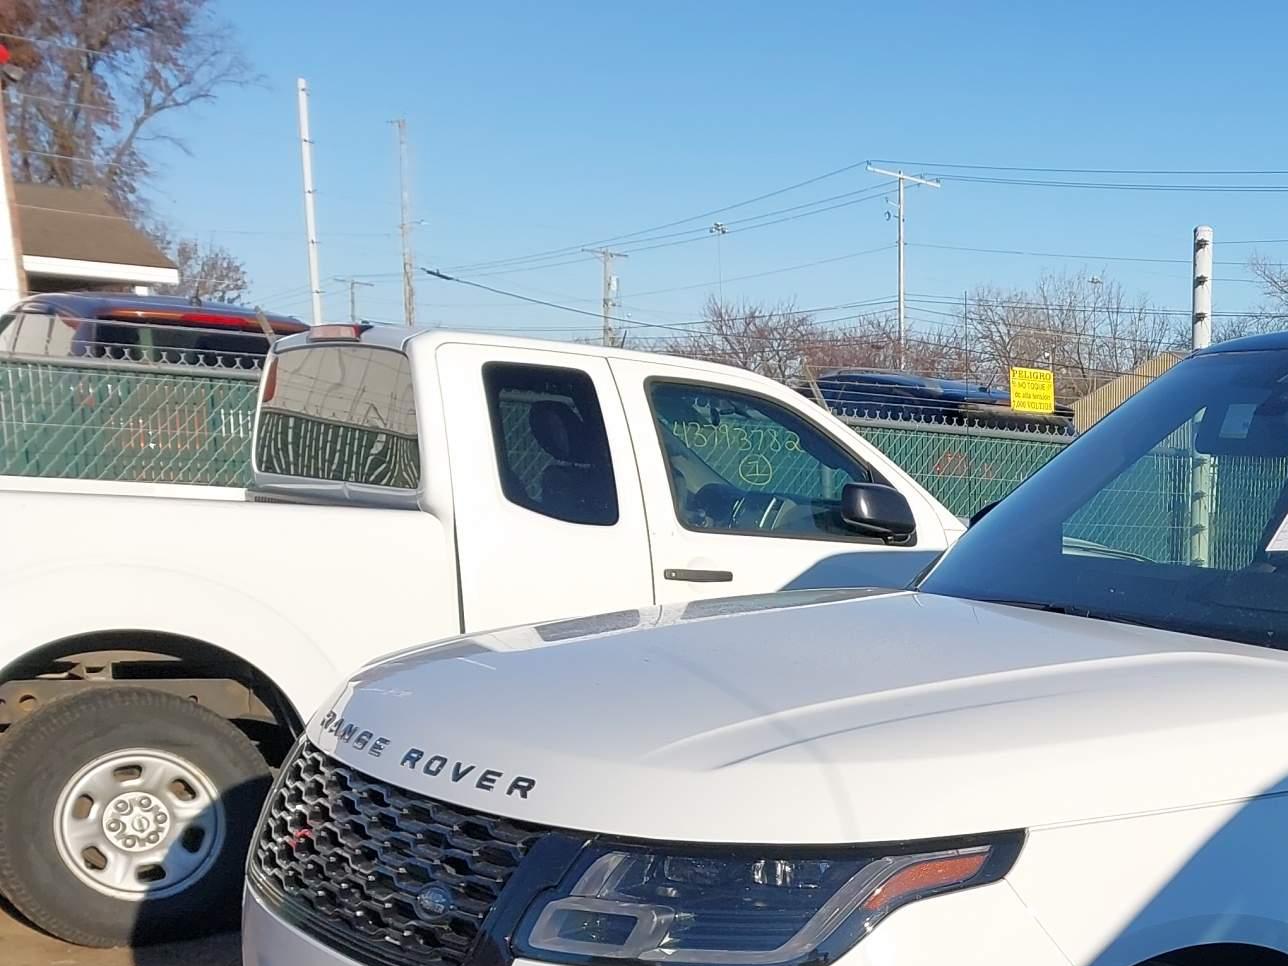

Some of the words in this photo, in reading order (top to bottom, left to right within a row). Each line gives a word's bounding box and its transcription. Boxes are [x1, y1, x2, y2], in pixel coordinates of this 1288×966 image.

[1012, 369, 1052, 381] PELIGRO
[672, 420, 806, 453] 43793782
[320, 710, 391, 758] RANGE
[400, 748, 536, 799] ROVER
